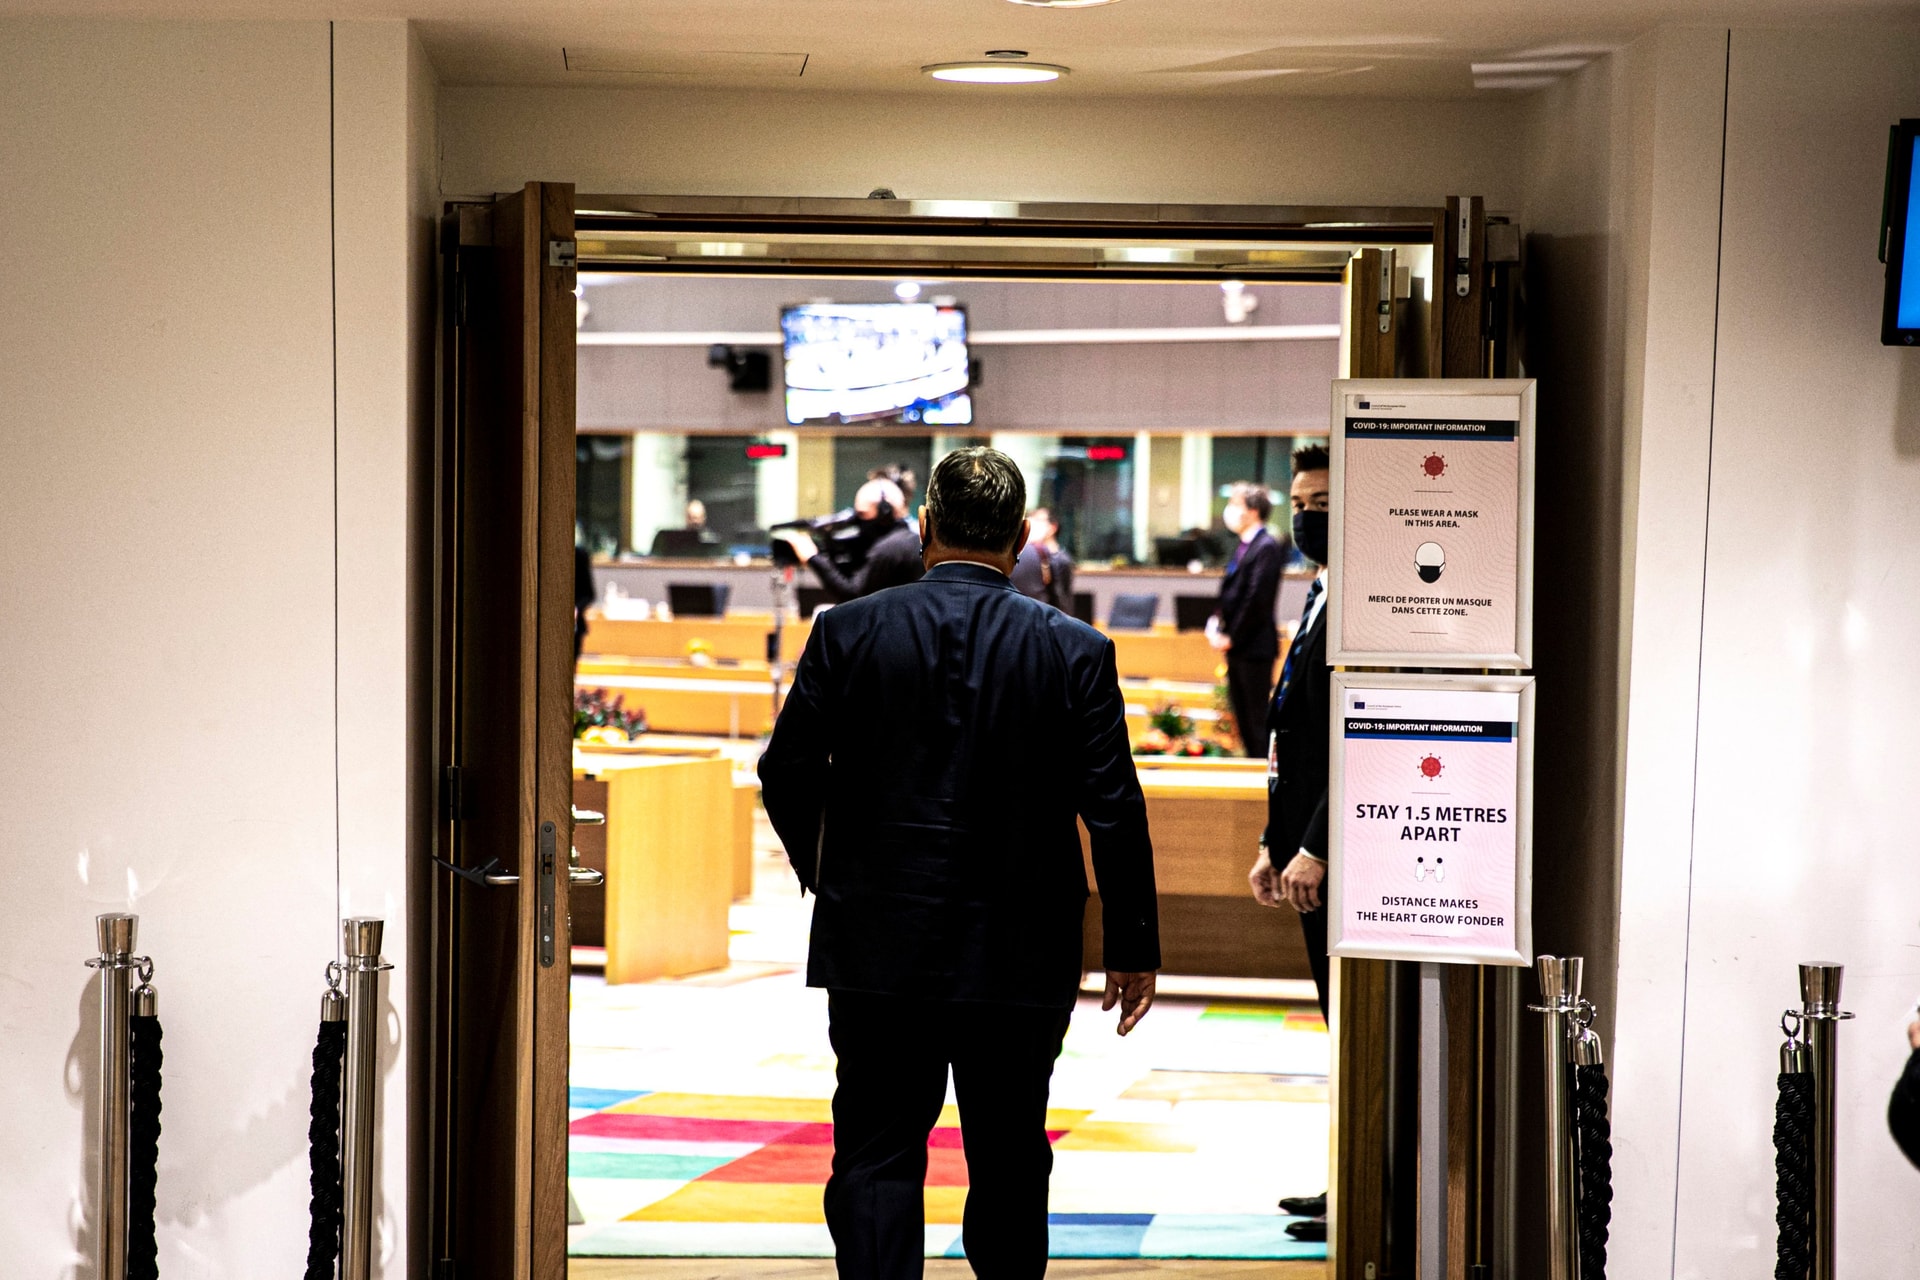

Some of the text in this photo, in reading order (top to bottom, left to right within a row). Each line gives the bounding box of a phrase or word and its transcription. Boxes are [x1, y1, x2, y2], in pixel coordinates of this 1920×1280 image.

[1352, 422, 1486, 432] COVID-19: IMPORTANT INFORMATION
[1389, 508, 1479, 518] PLEASE WEAR A MASK
[1404, 519, 1461, 529] IN THIS AREA.
[1368, 595, 1492, 607] MERCI DE PORTER UN MASQUE
[1391, 606, 1469, 617] DANS CETTE ZONE.
[1348, 722, 1483, 733] COVID-19: IMPORTANT INFORMATION
[1356, 804, 1507, 824] STAY 1.5 METRES
[1400, 826, 1462, 842] APART
[1381, 896, 1479, 910] DISTANCE MAKES
[1356, 912, 1504, 927] THE HEART GROW FONDER
